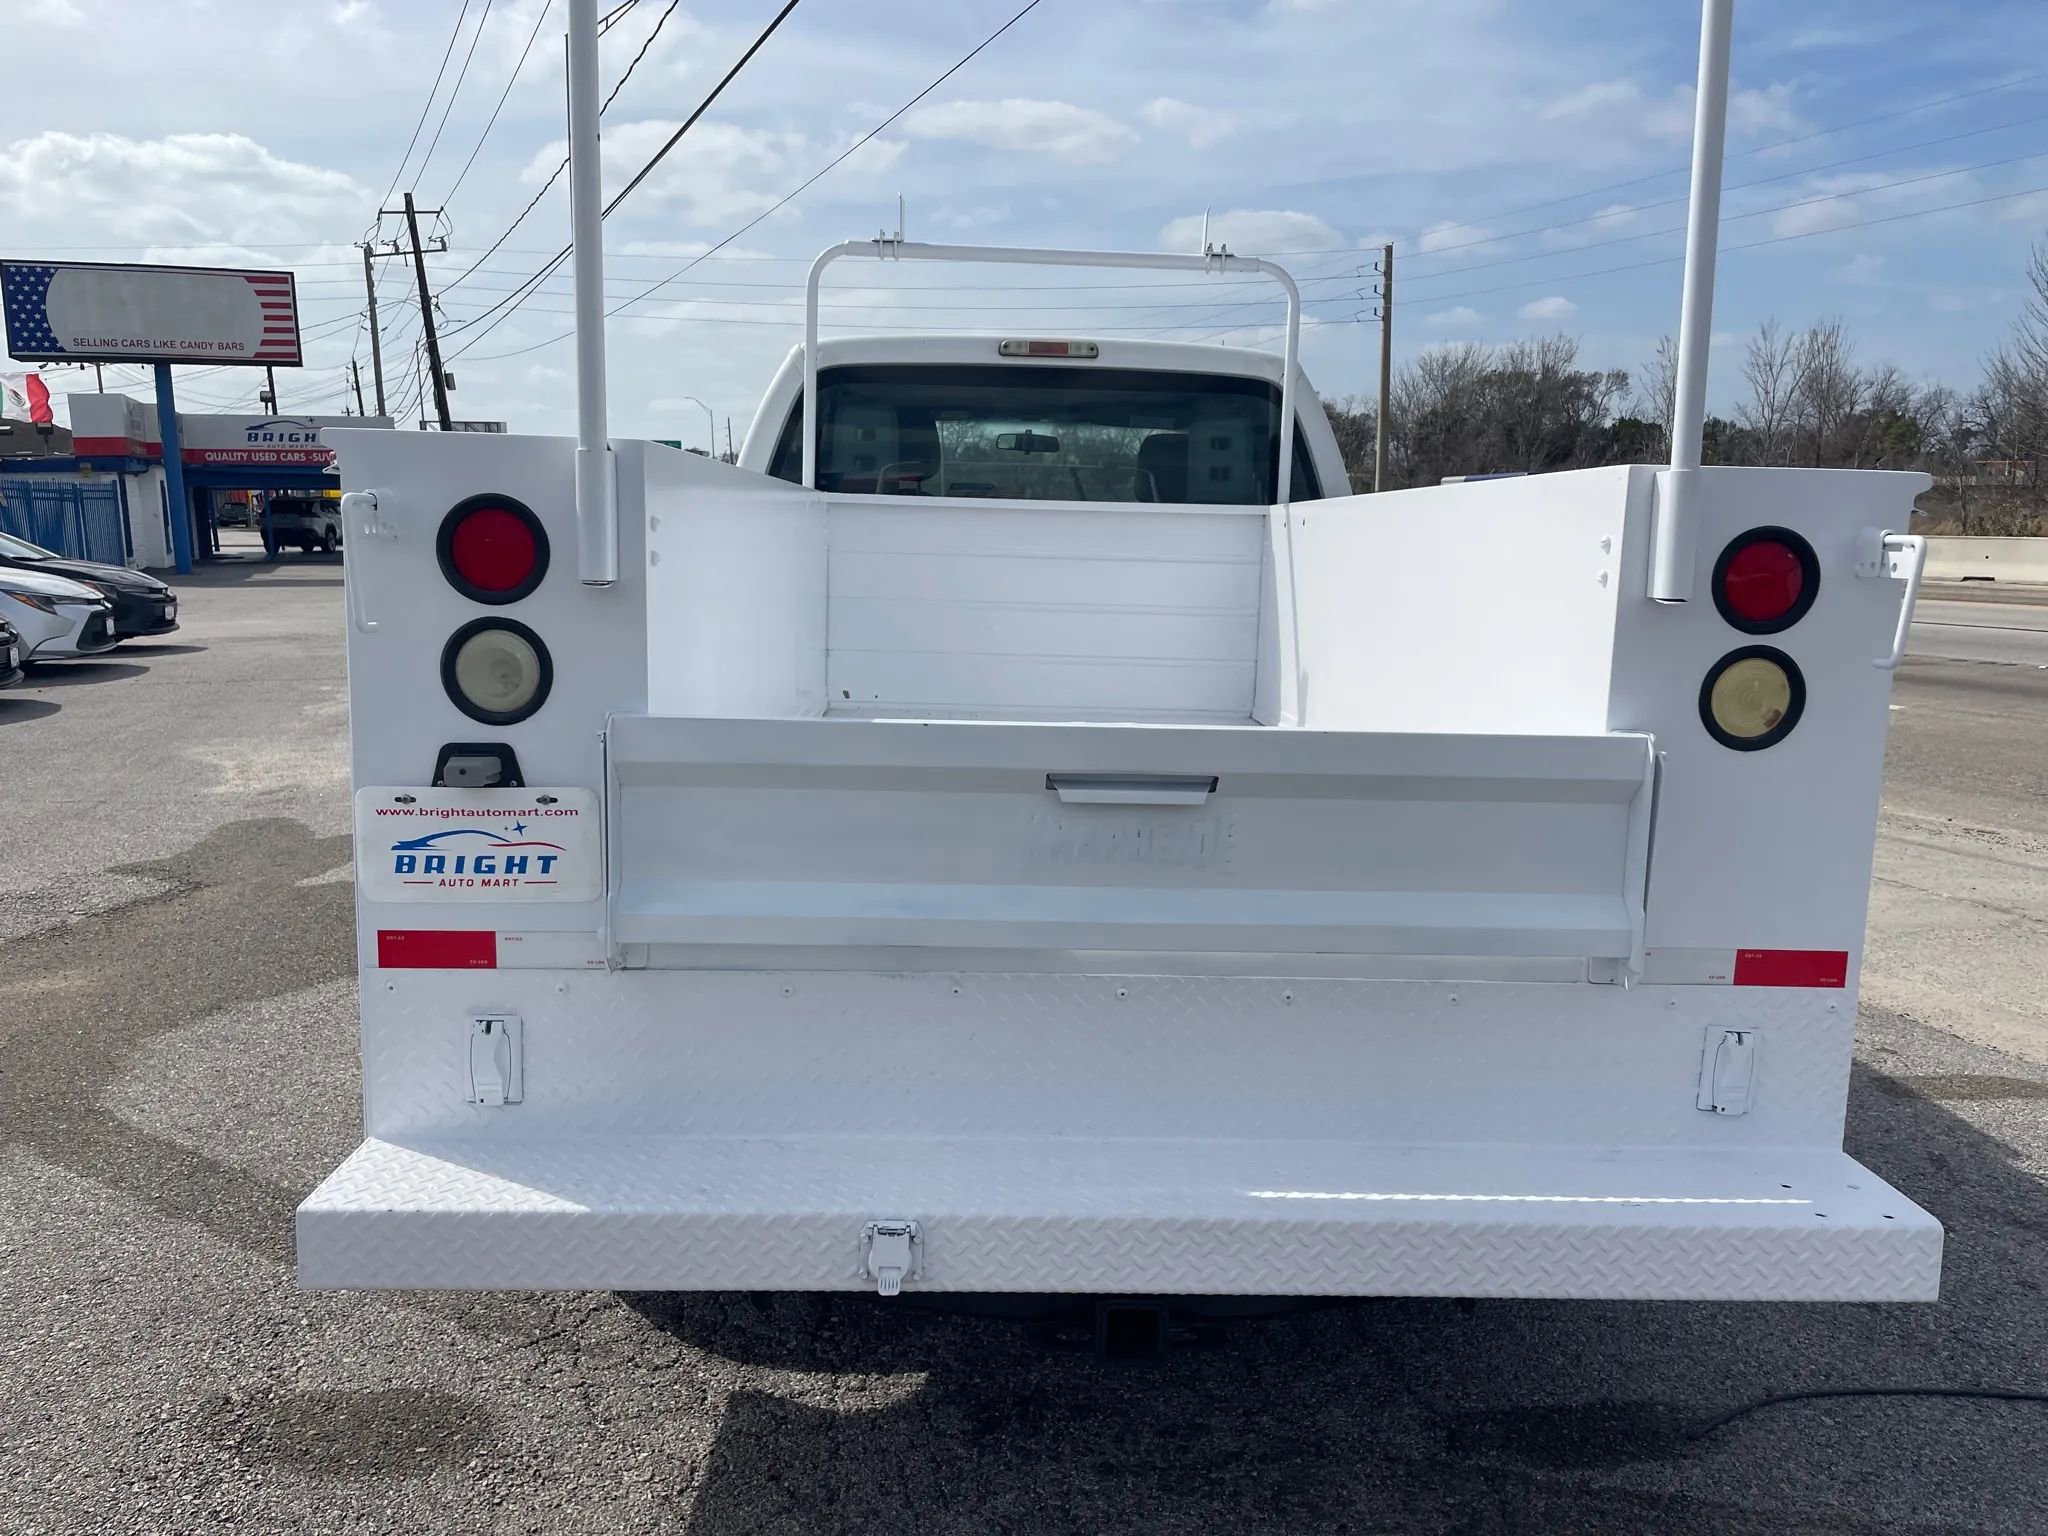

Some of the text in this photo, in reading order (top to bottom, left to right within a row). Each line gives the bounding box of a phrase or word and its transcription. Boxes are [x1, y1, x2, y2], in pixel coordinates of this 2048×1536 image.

[73, 337, 245, 351] SELLING CARS LIKE CANDY BARS
[247, 432, 317, 442] BRIGH
[205, 451, 249, 462] QUALITY
[251, 452, 277, 462] USED
[280, 452, 306, 462] CARS
[375, 807, 579, 819] www.brightautomart.com
[394, 854, 558, 875] BRIGHT
[438, 878, 519, 887] AUTO MART
